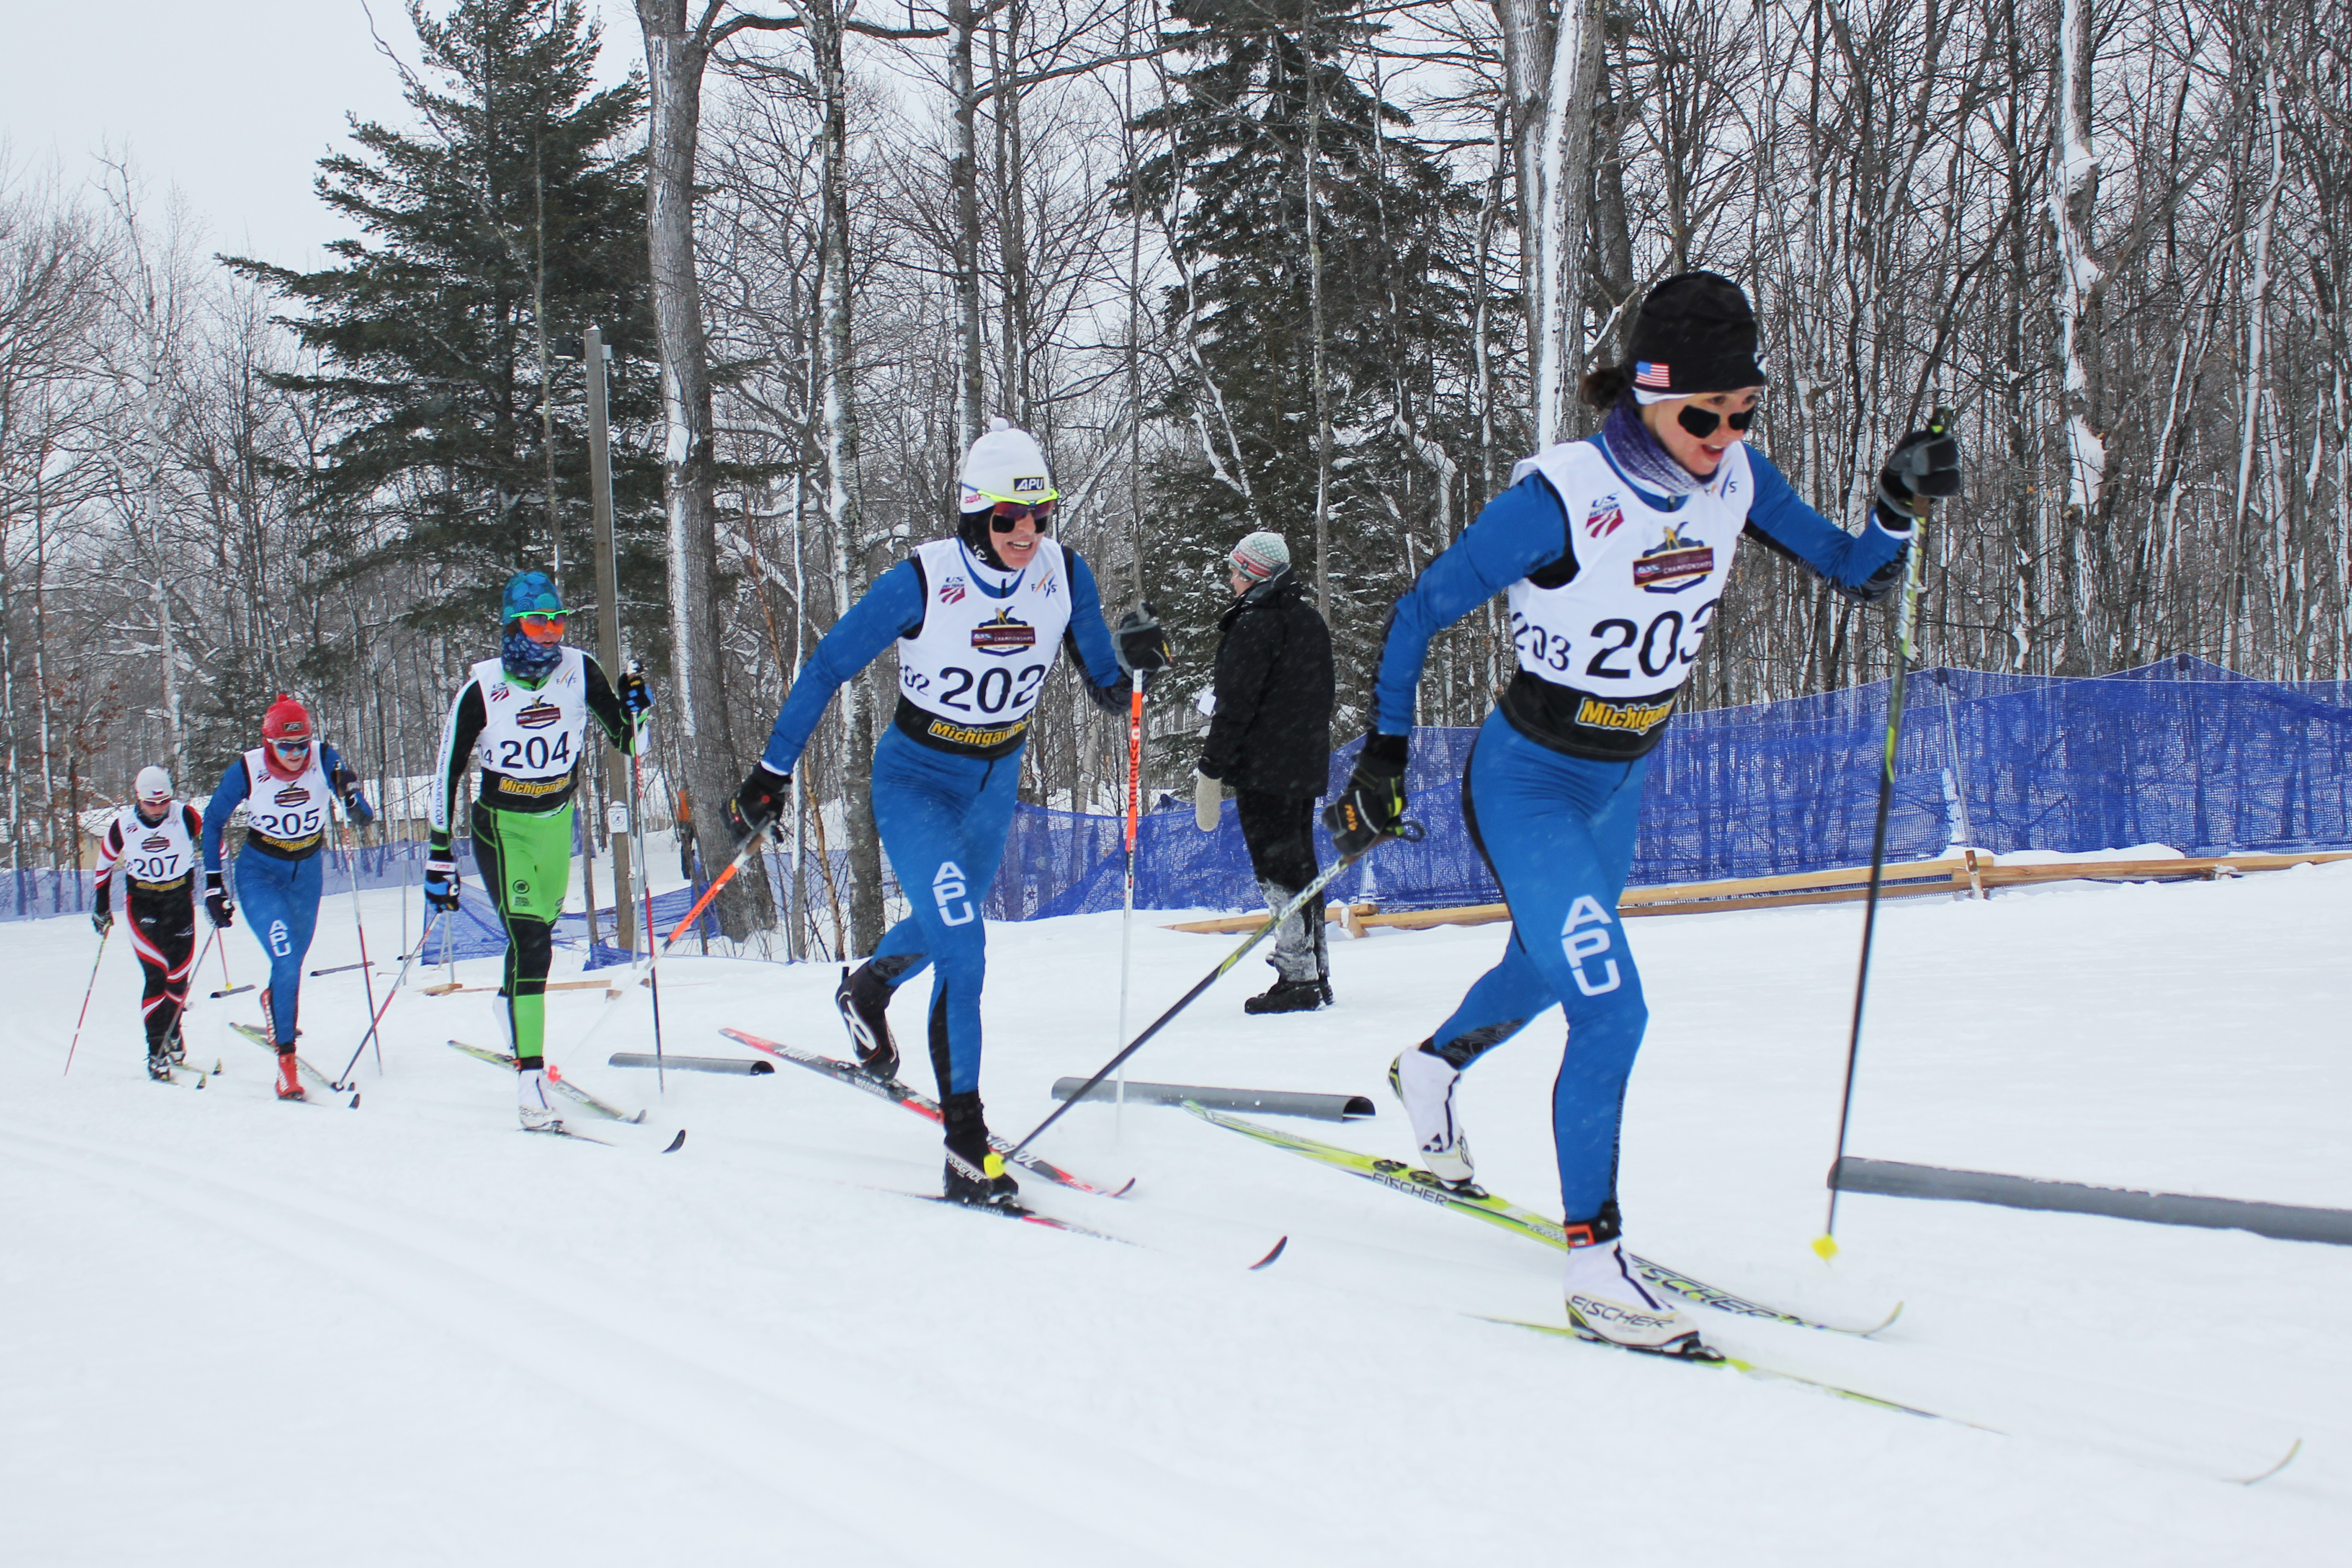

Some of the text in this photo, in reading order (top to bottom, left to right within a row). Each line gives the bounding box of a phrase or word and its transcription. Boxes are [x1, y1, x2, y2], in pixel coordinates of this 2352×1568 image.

[1015, 478, 1043, 491] APU
[1592, 491, 1620, 507] US
[1031, 583, 1057, 593] FIS
[939, 664, 1046, 714] 202
[931, 721, 1010, 745] Michigan
[500, 730, 569, 769] 204
[500, 778, 556, 796] Michigan
[261, 808, 320, 835] 205
[133, 854, 180, 877] 207
[932, 861, 975, 927] APU
[1279, 859, 1341, 920] FISCHER
[269, 919, 292, 957] APU
[1561, 894, 1621, 996] APU
[854, 1077, 890, 1100] ROSSIGNOL
[1372, 1172, 1449, 1207] FISCHER
[1572, 1295, 1675, 1329] FISCHER
